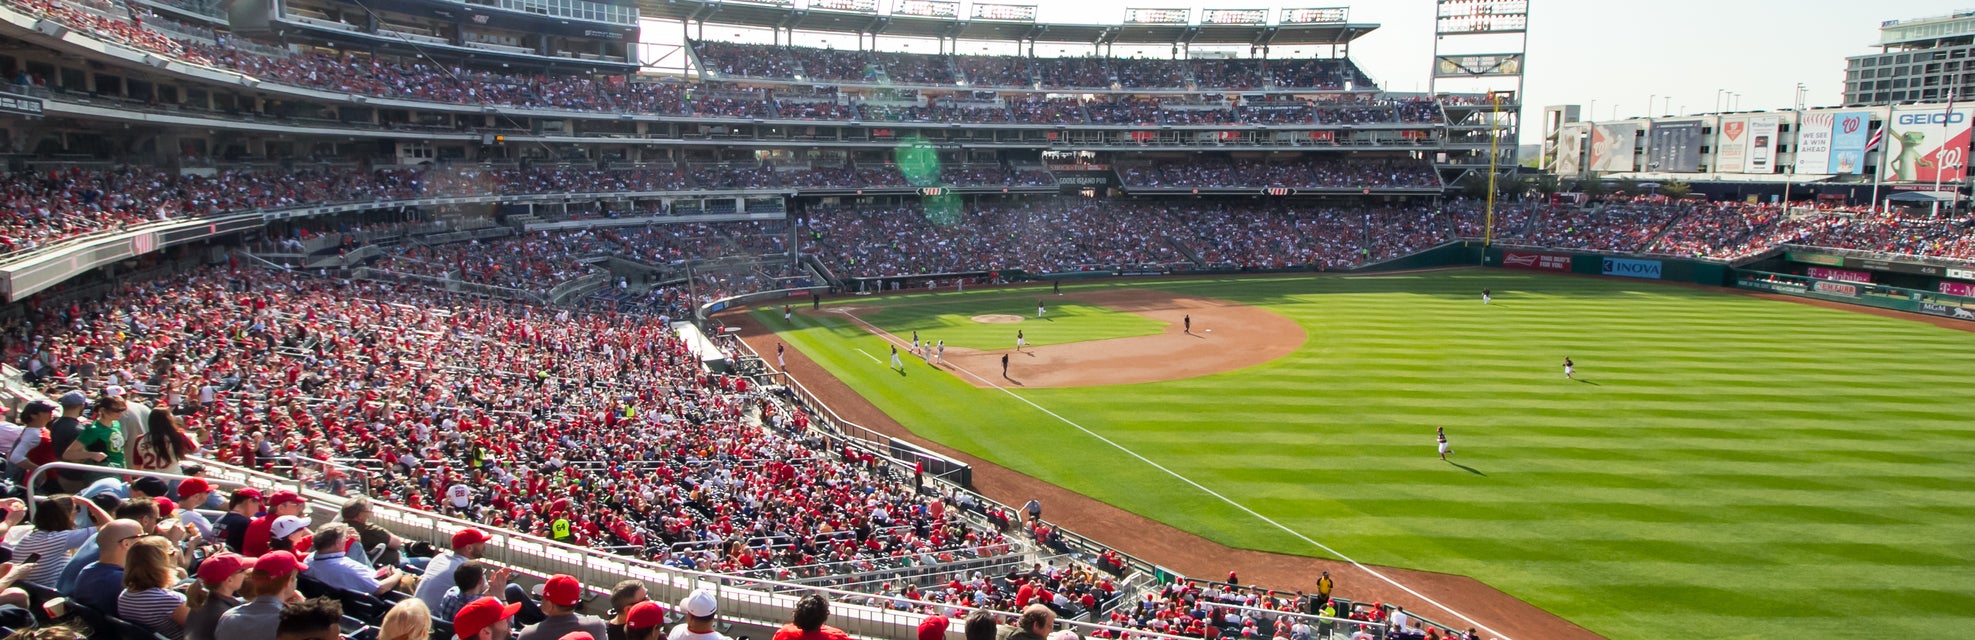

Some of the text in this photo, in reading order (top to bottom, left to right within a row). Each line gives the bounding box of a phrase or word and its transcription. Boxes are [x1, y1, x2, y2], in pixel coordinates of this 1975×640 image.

[1899, 112, 1964, 125] GEICO
[1616, 262, 1660, 275] INOVA
[1923, 303, 1947, 312] MGM
[556, 523, 566, 532] 64
